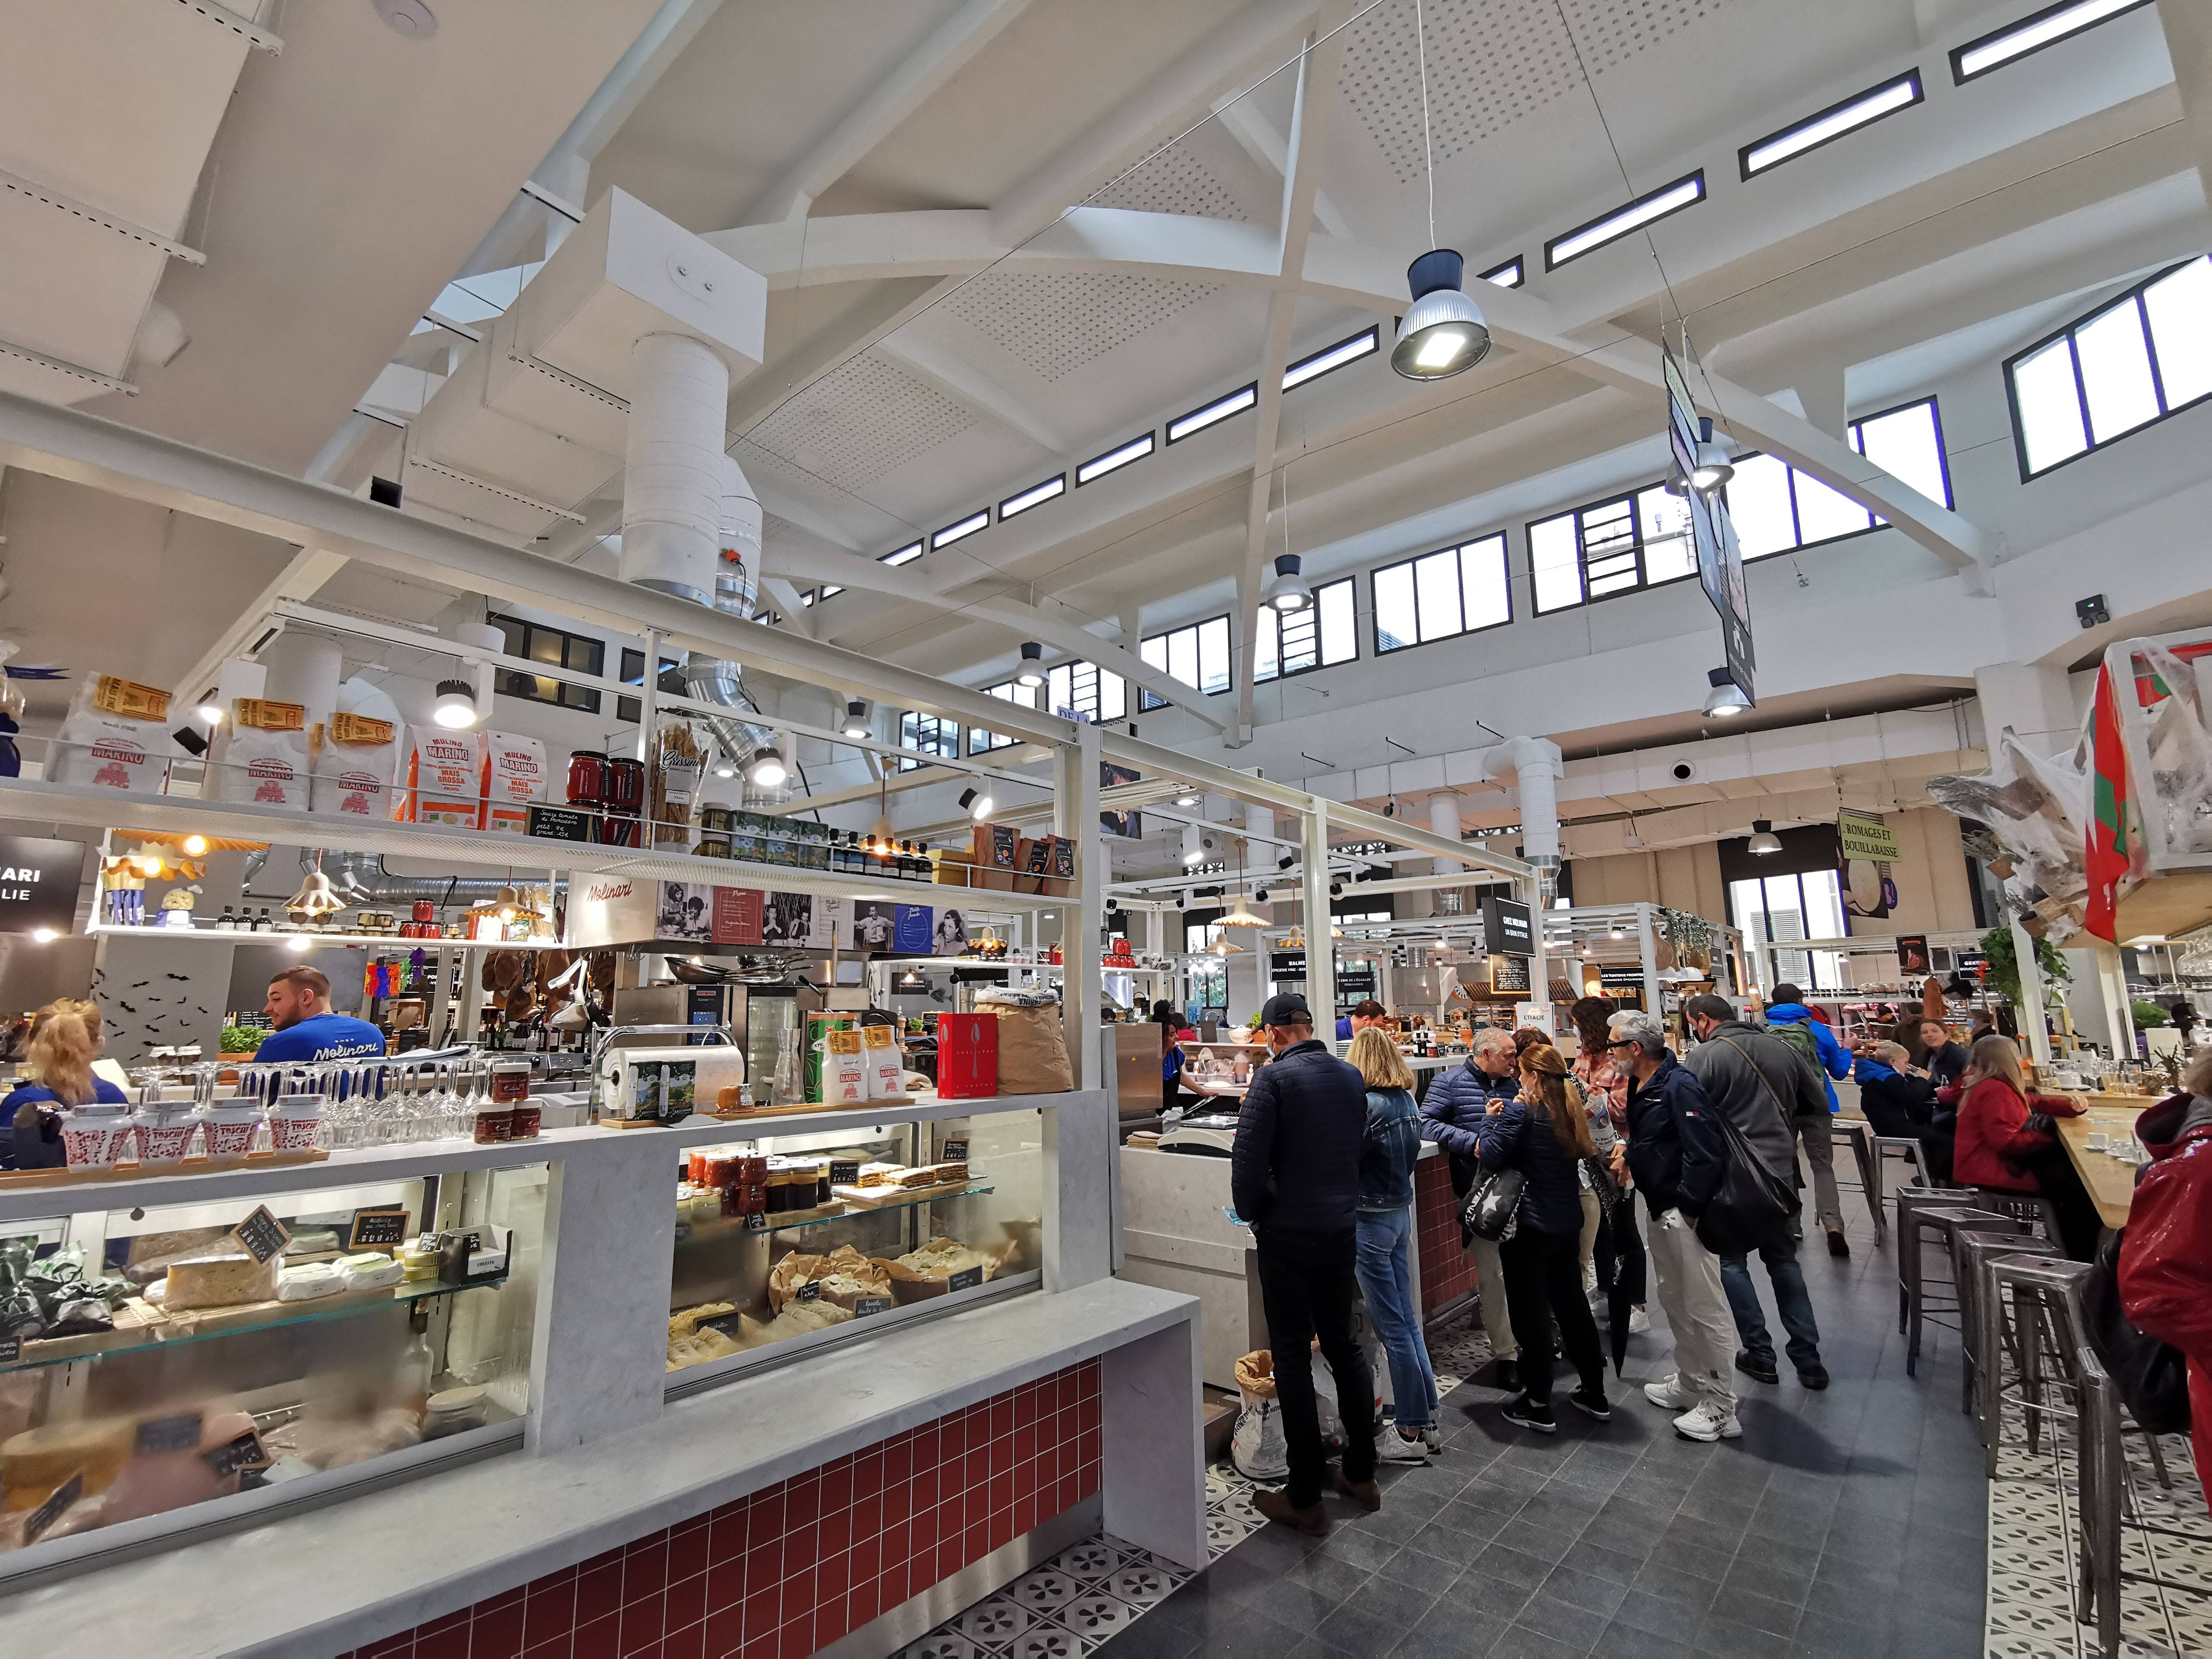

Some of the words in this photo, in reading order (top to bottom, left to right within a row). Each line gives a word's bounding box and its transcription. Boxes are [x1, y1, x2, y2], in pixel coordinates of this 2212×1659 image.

[432, 739, 462, 747] MULINO
[427, 747, 468, 760] MARINO
[505, 752, 532, 761] MULINO
[659, 750, 701, 771] Grissini
[500, 759, 537, 773] MARINO
[508, 786, 534, 795] GROSSA
[1882, 830, 1891, 840] ET
[1844, 839, 1898, 858] BOUILLABAISSE
[0, 867, 41, 882] ARI
[2, 888, 31, 900] LIE
[587, 880, 632, 903] Molinari
[312, 1042, 379, 1062] Molinari
[840, 1074, 861, 1082] MARINO
[880, 1069, 899, 1077] MARINO
[220, 1126, 250, 1135] TOSCHI
[291, 1122, 318, 1130] TOSCHI
[153, 1130, 184, 1139] TOSCHI
